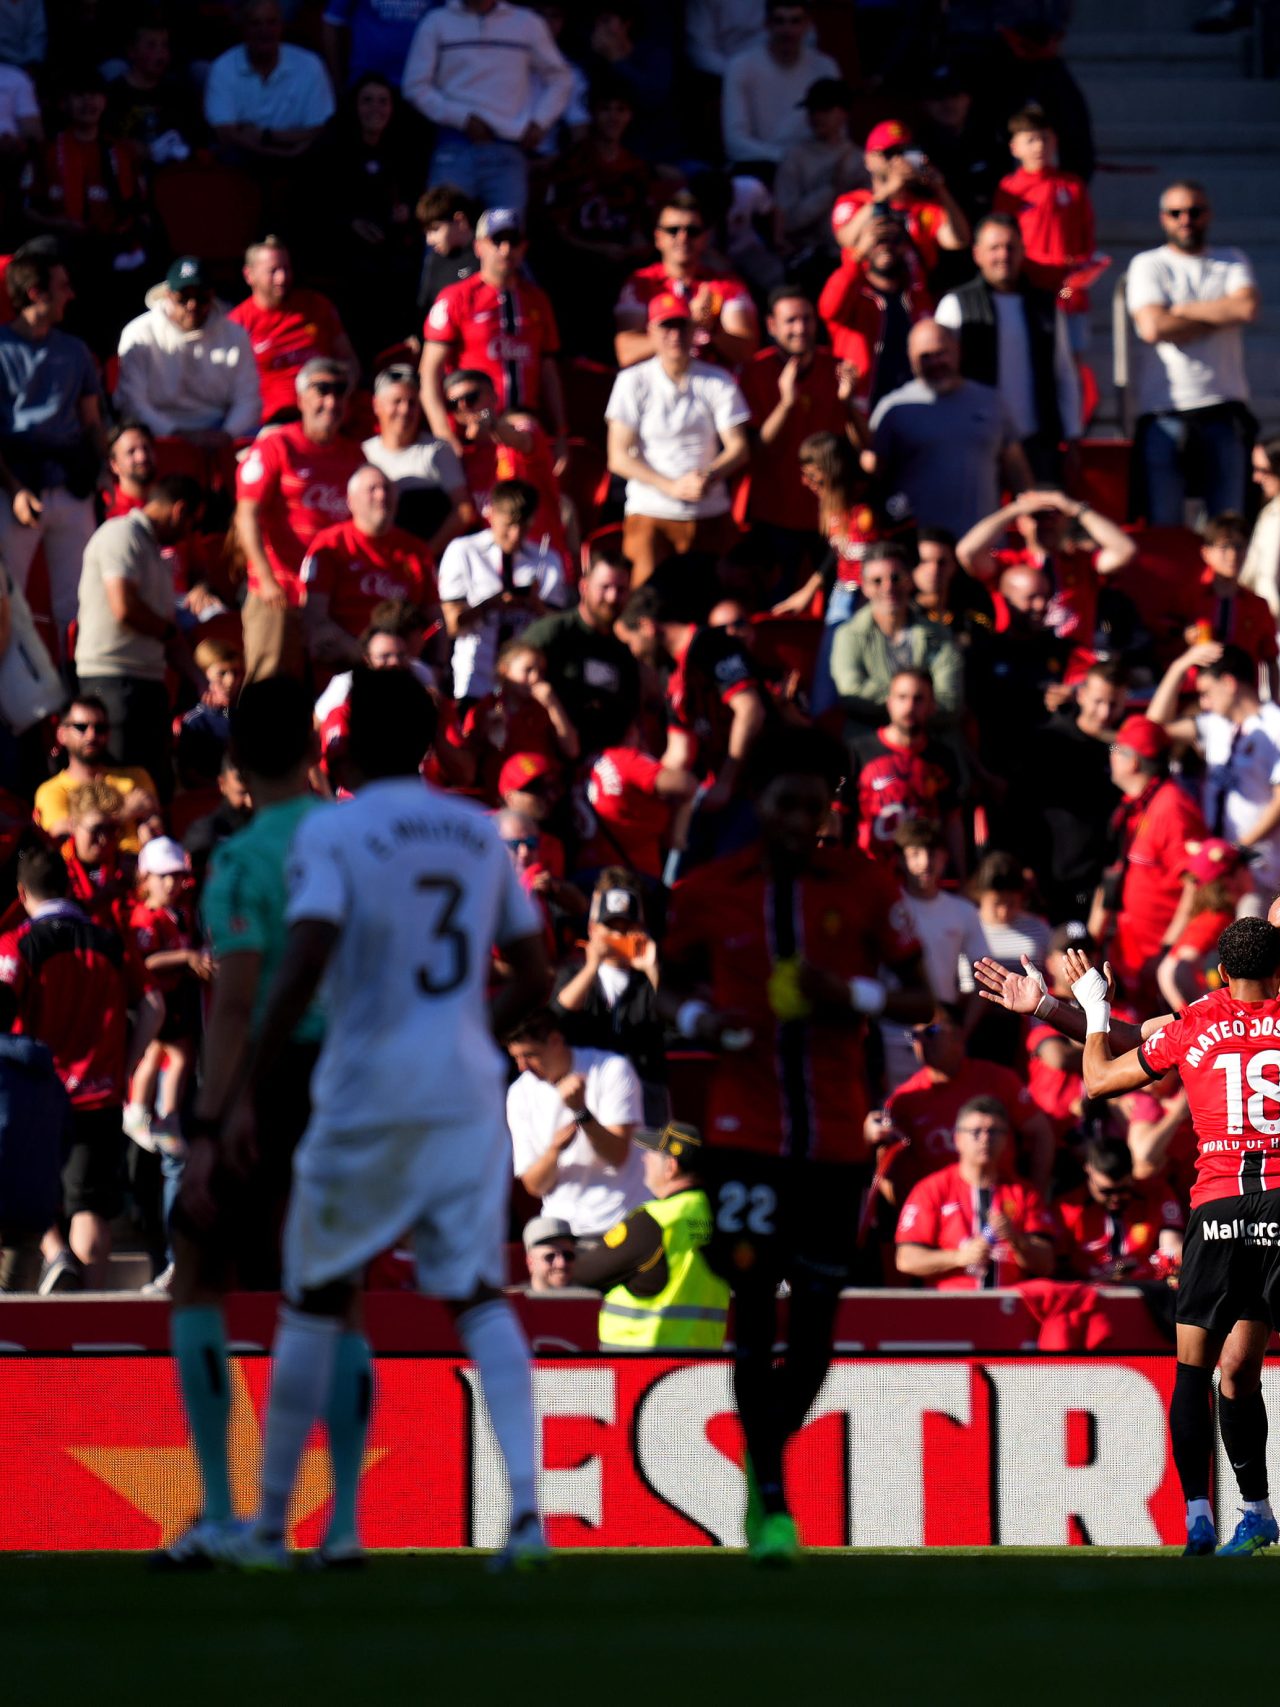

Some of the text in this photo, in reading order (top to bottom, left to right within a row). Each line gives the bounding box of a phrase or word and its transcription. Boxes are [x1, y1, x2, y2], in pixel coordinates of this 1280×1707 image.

[417, 873, 468, 999] 3
[1185, 1020, 1245, 1068] MATEO
[1202, 1140, 1240, 1153] WORLD
[1246, 1140, 1264, 1149] OF
[717, 1180, 777, 1234] 22
